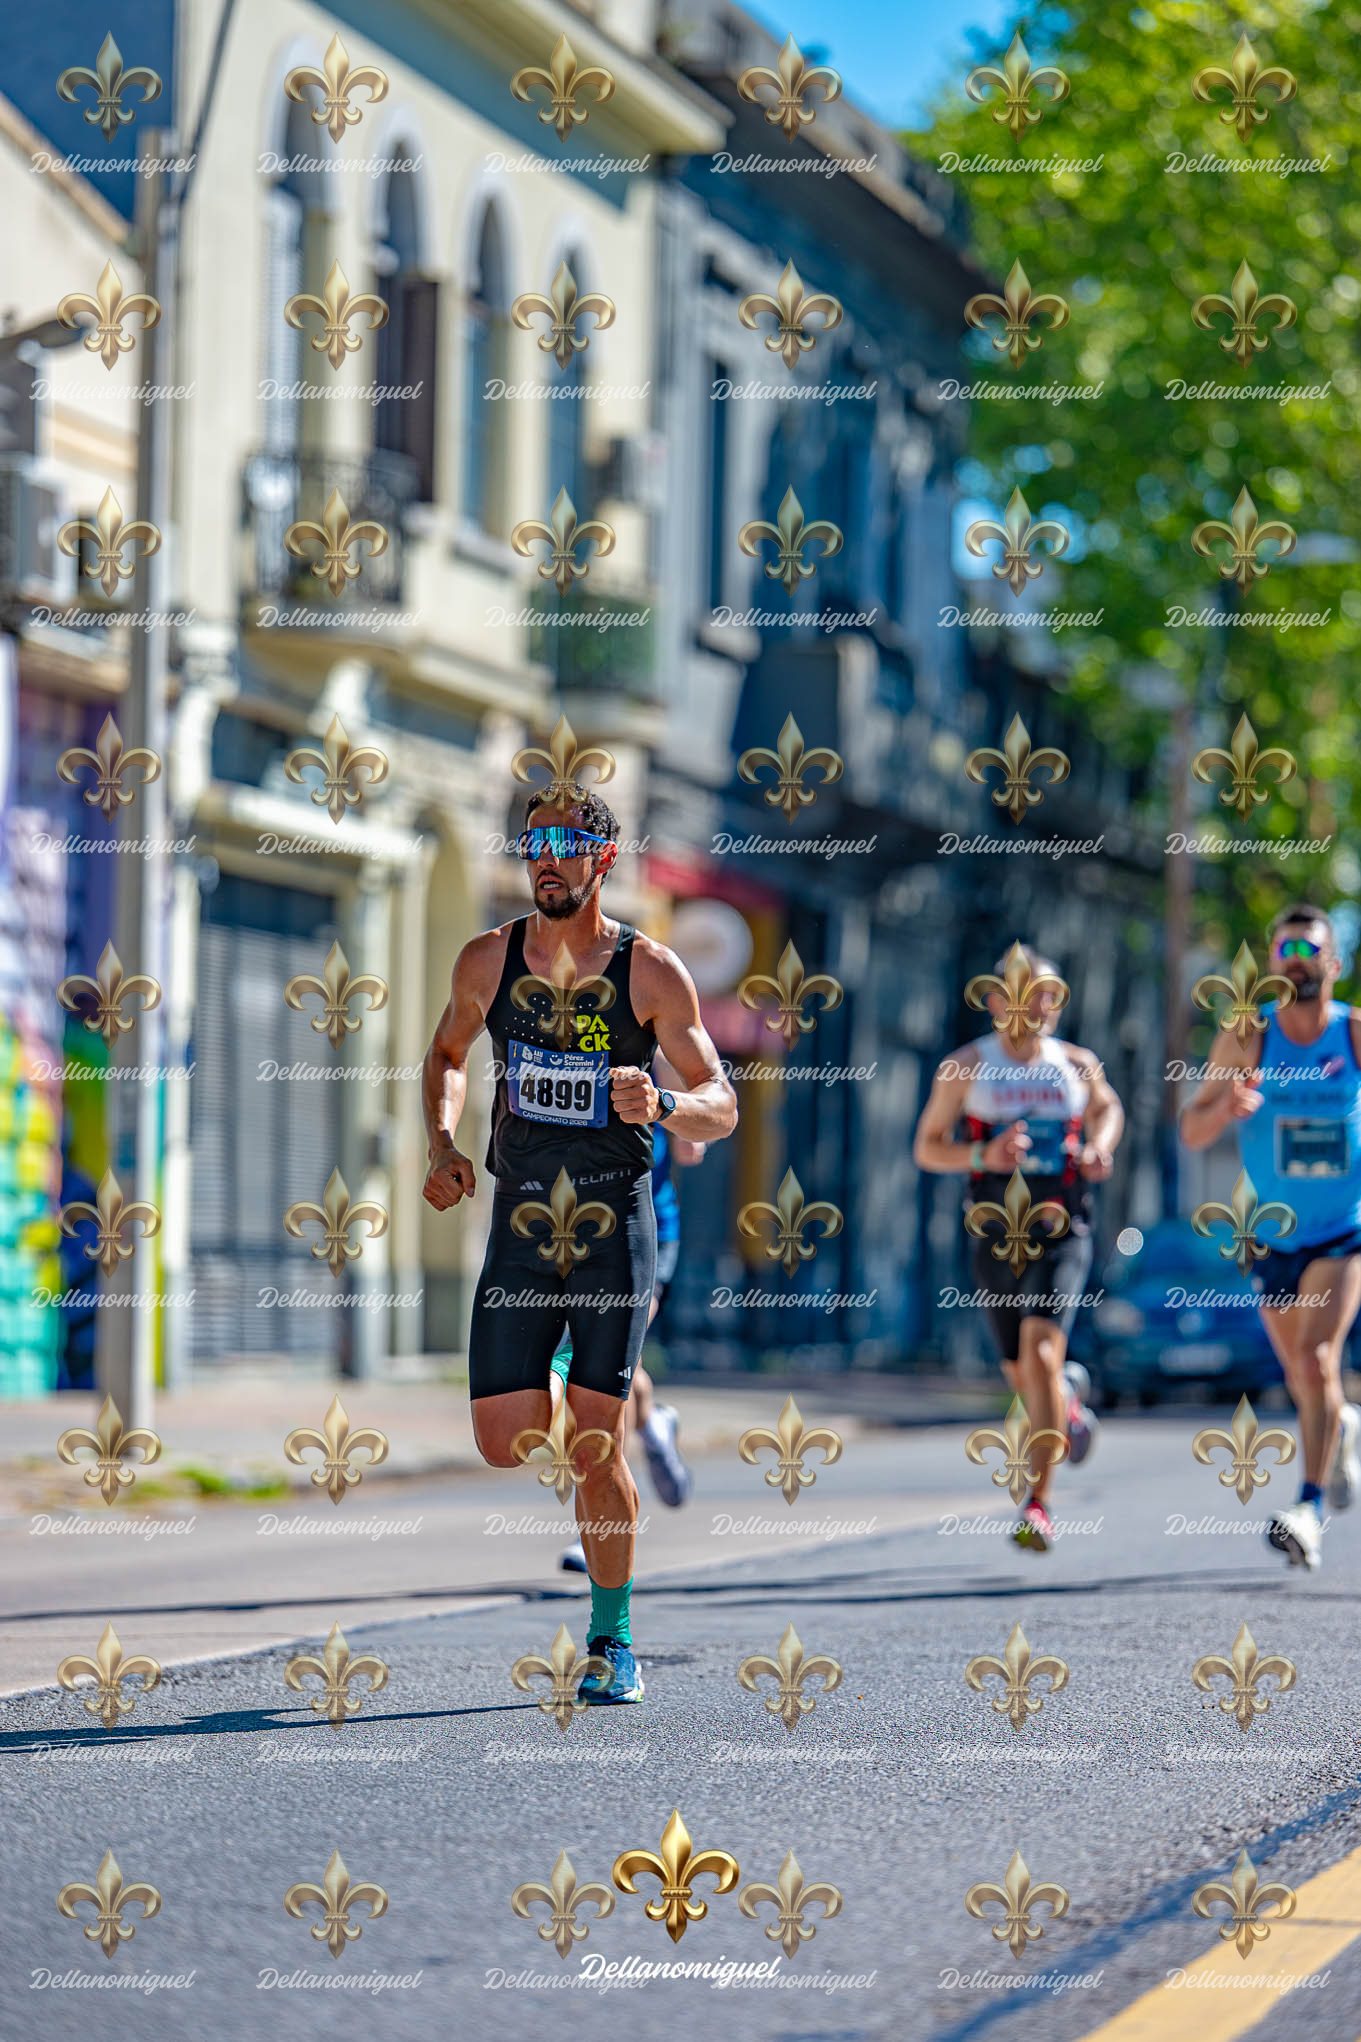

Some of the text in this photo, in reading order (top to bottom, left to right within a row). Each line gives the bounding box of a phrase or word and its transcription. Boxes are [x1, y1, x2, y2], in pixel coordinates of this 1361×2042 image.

[580, 1033, 611, 1052] CK
[563, 1059, 594, 1067] Scremini
[564, 1053, 584, 1061] Pérez
[520, 1072, 592, 1112] 4899
[522, 1111, 569, 1125] CAMPEONATO
